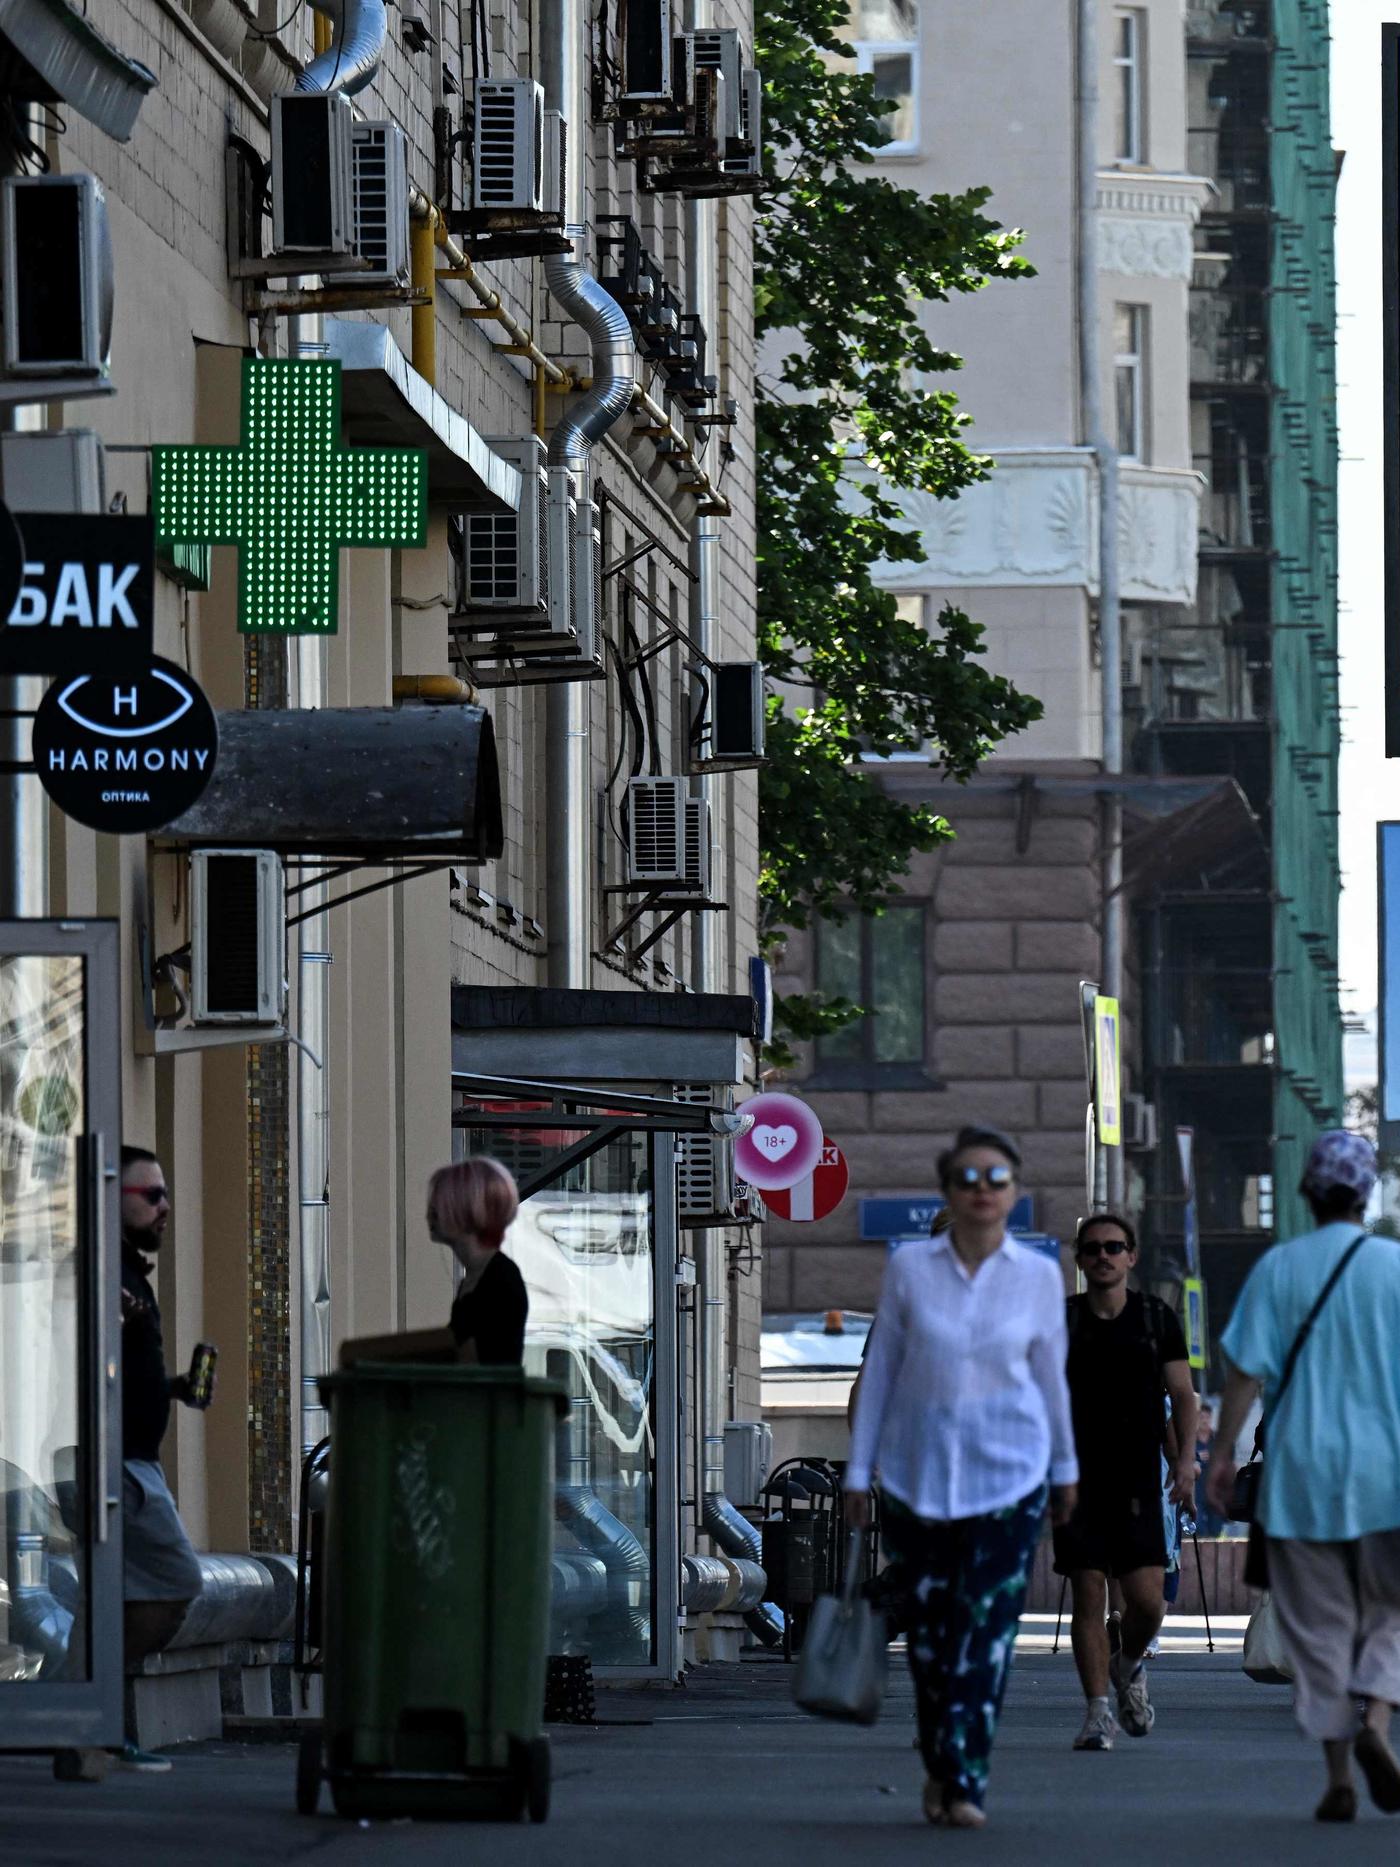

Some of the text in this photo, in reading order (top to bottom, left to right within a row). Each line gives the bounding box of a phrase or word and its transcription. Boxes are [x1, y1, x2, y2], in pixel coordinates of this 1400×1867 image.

[114, 686, 137, 716] H
[49, 749, 209, 771] HARMONY
[763, 1136, 786, 1148] 18+
